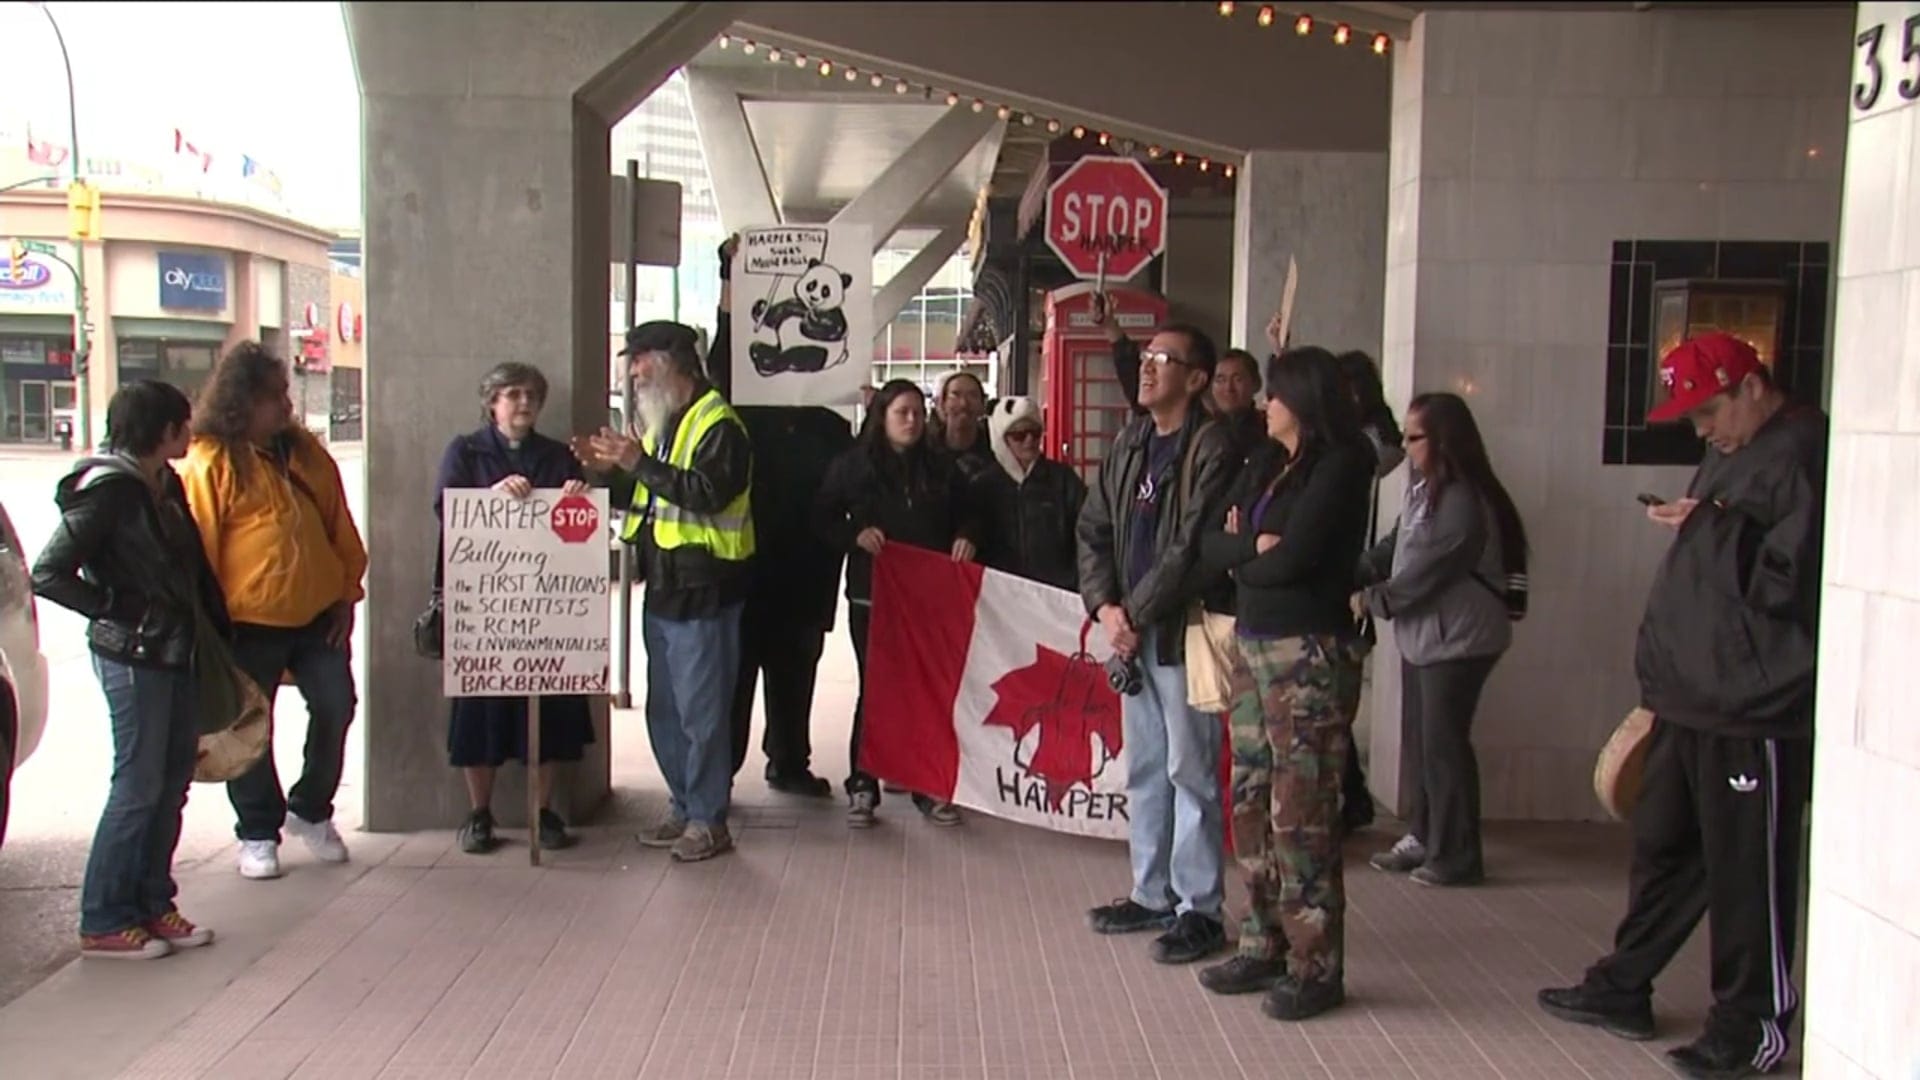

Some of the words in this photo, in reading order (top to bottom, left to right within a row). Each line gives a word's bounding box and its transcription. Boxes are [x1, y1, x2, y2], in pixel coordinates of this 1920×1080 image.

[1060, 192, 1152, 243] STOP
[749, 233, 793, 246] HARPER
[450, 498, 550, 530] HARPER
[554, 508, 598, 526] STOP
[449, 536, 549, 576] Bullying
[455, 579, 472, 592] the
[478, 574, 528, 595] FIRST
[535, 574, 607, 595] NATIONS
[454, 600, 472, 614] the
[480, 598, 589, 616] SCIENTISTS
[454, 618, 475, 633] the
[483, 617, 541, 636] RCMP
[452, 656, 502, 675] YOUR
[513, 656, 565, 673] OWN
[461, 665, 609, 693] BACKBENCHERS!
[996, 766, 1131, 822] HARPER
